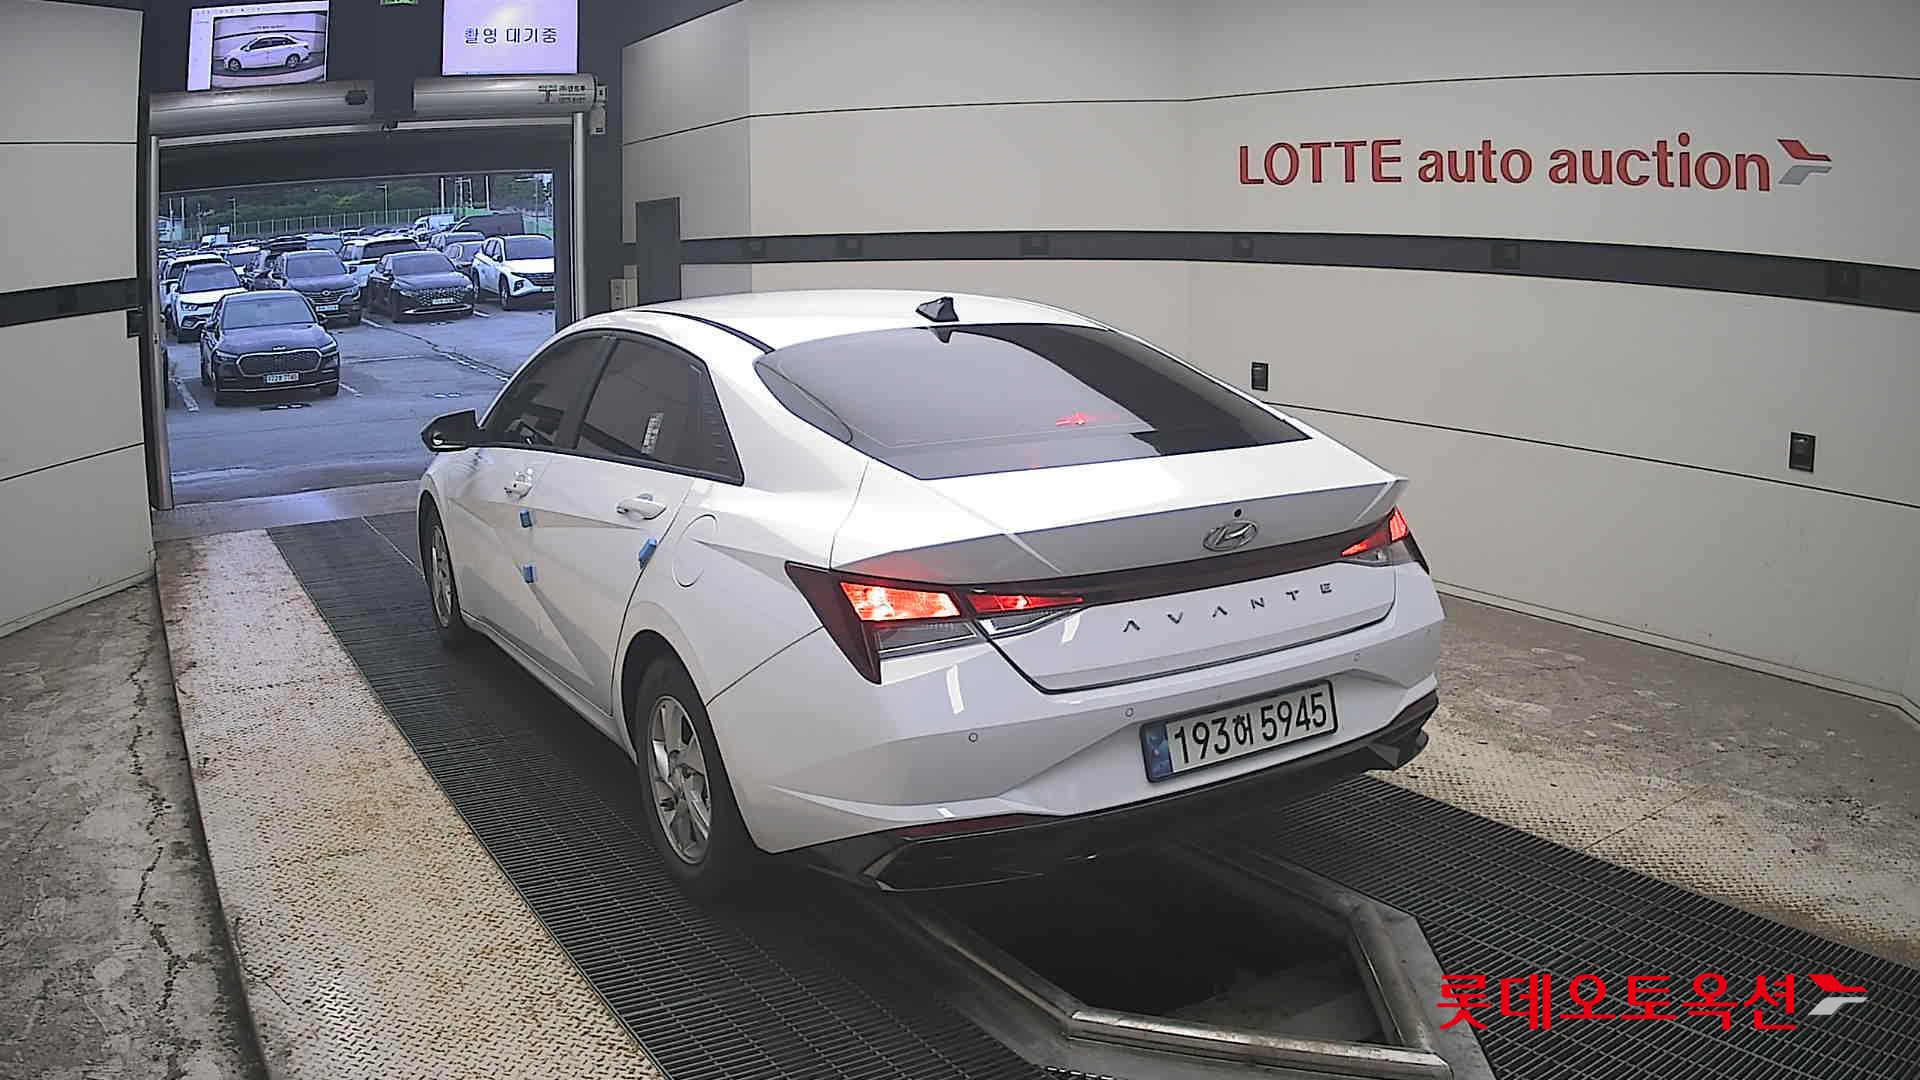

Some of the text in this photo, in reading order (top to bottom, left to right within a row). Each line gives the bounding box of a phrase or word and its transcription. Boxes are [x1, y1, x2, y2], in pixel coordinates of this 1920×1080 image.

[505, 27, 558, 44] 대기중
[1238, 131, 1772, 192] LOTTE auto auction
[1122, 581, 1333, 633] AVANTE
